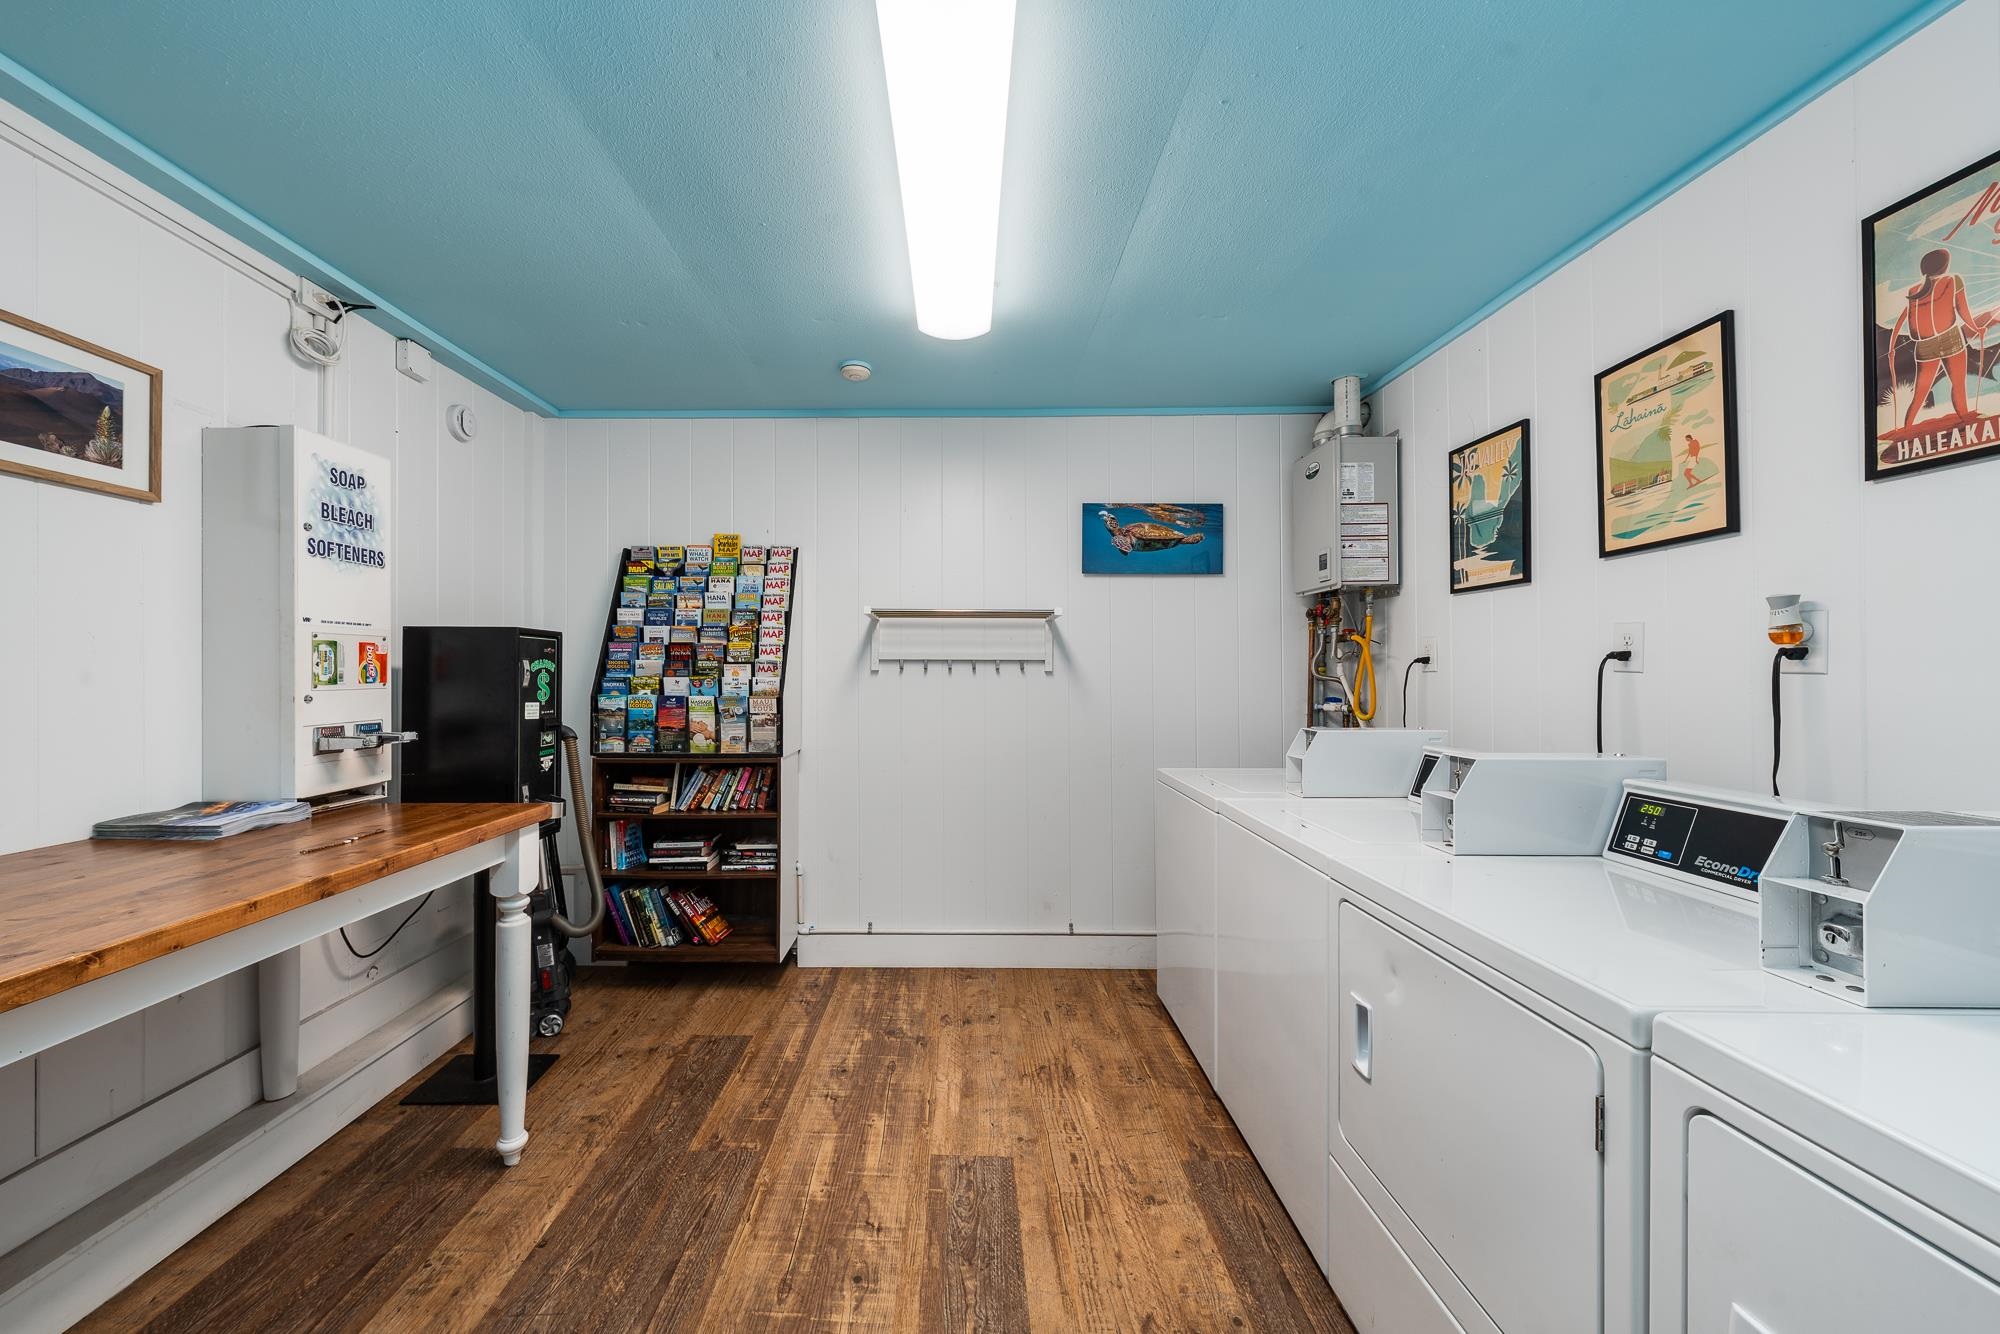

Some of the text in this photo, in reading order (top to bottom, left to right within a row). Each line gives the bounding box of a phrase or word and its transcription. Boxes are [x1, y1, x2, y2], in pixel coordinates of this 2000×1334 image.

[1897, 417, 2000, 461] HALEAKA
[330, 467, 366, 489] SOAP
[321, 502, 374, 529] BLEACH
[308, 537, 384, 567] SOFTENERS
[743, 549, 763, 558] MAP
[772, 549, 792, 557] MAP
[653, 582, 674, 590] SAILING
[765, 581, 786, 589] MAP
[764, 597, 785, 605] MAP
[762, 613, 783, 621] MAP
[762, 630, 783, 638] MAP
[760, 647, 781, 655] MAP
[757, 665, 779, 673] MAP
[1640, 804, 1662, 816] 250
[1700, 867, 1733, 880] COMMERCIAL
